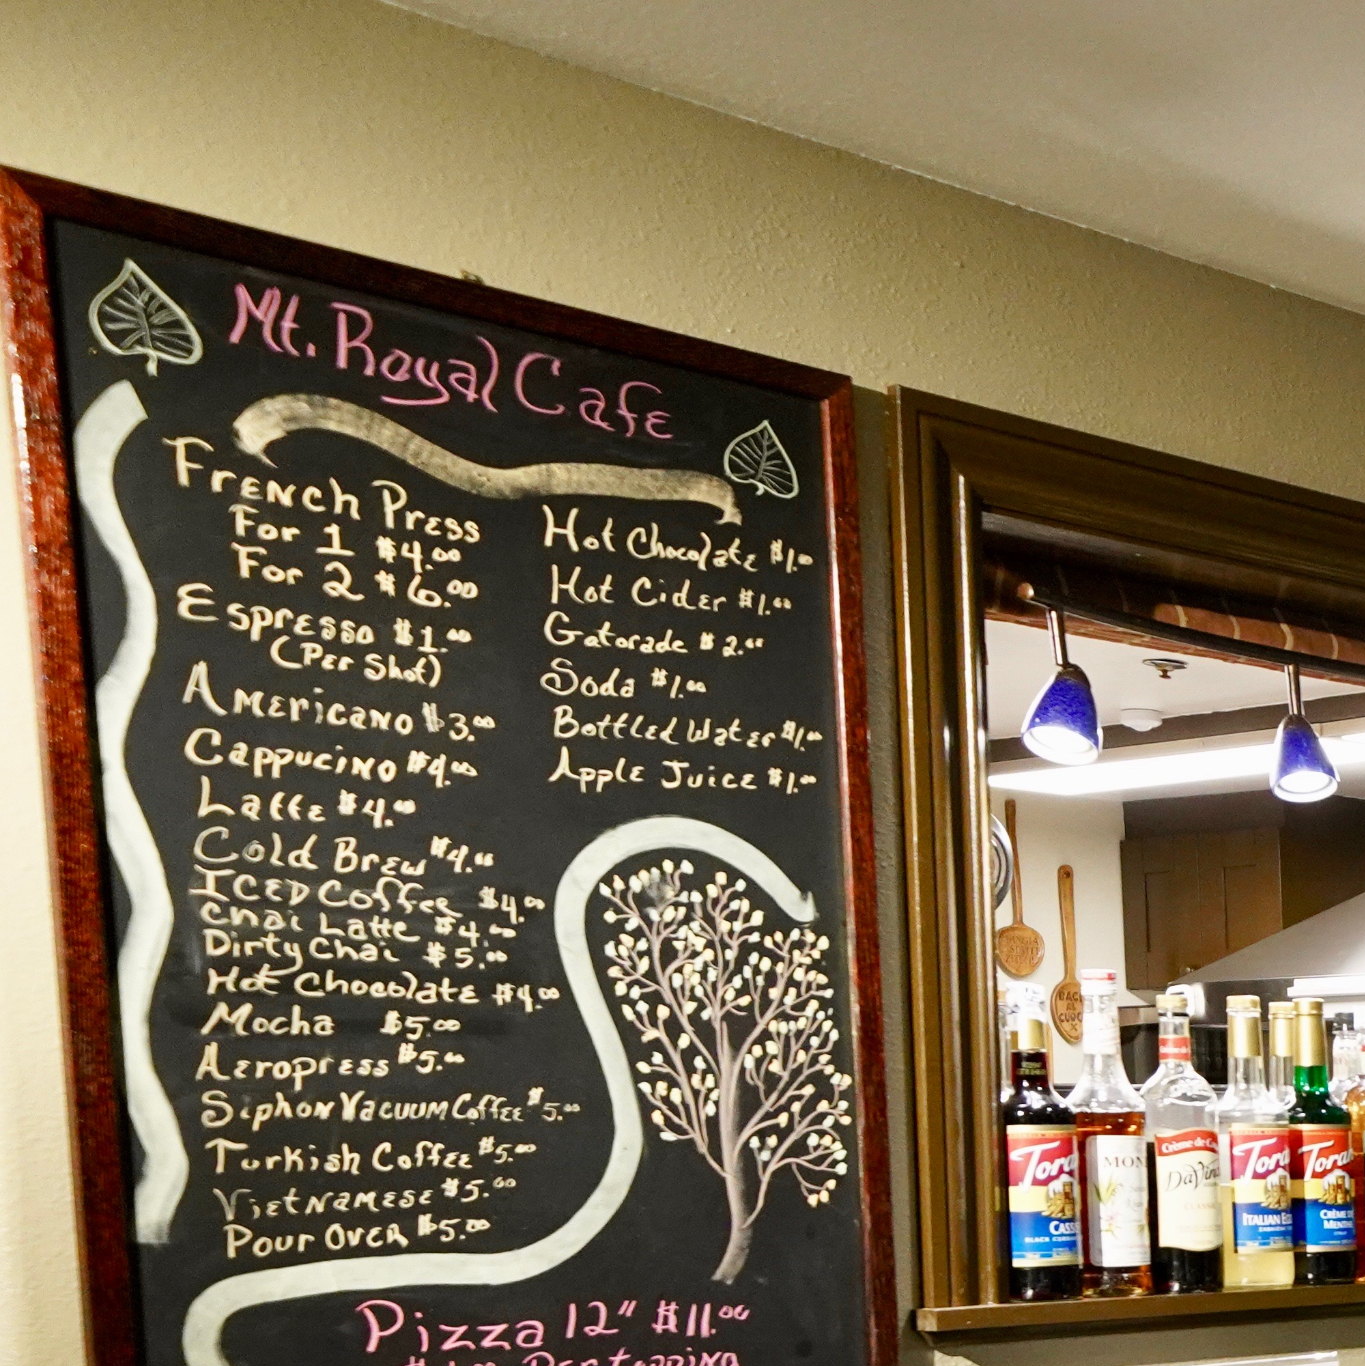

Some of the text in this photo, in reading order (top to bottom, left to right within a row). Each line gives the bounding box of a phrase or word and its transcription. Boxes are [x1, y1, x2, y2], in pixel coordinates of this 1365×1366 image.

[229, 283, 673, 439] Mt. Royal Cafe
[229, 503, 462, 574] For 1 $4.00
[542, 504, 616, 552] Hot
[627, 522, 758, 572] Chocolate
[231, 541, 479, 608] For 2 $6.00
[551, 564, 615, 604] Hot
[631, 576, 727, 613] Cider
[177, 582, 472, 653] Espresso $1.00
[544, 610, 688, 654] Gatorade
[364, 652, 442, 688] Shot)
[540, 657, 636, 698] Soda
[422, 702, 496, 742] $3.00
[553, 705, 680, 745] Bottled
[687, 718, 775, 748] Water
[406, 750, 478, 788] $4.00
[548, 746, 645, 793] Apple
[661, 760, 758, 789] Juice
[197, 775, 416, 829] Latte $4.00
[193, 826, 319, 870] Cold
[333, 836, 427, 876] Brew
[318, 876, 463, 918] Coffee
[320, 912, 421, 942] Latte
[202, 928, 303, 977] Dirty
[309, 936, 400, 963] Chai
[206, 963, 280, 996] Hot
[294, 970, 480, 1005] Chocolate
[200, 1001, 461, 1040] Mocha $5.00
[195, 1041, 465, 1091] Aeropress $5.00
[452, 1093, 525, 1124] Coffee
[205, 1137, 360, 1174] Turkish
[372, 1141, 473, 1173] Coffee
[212, 1177, 516, 1222] Vietnamese $5.00
[1243, 1212, 1281, 1226] ITALIAN
[223, 1223, 315, 1259] Pour
[418, 1214, 491, 1242] $5.00
[356, 1299, 545, 1353] Pizza
